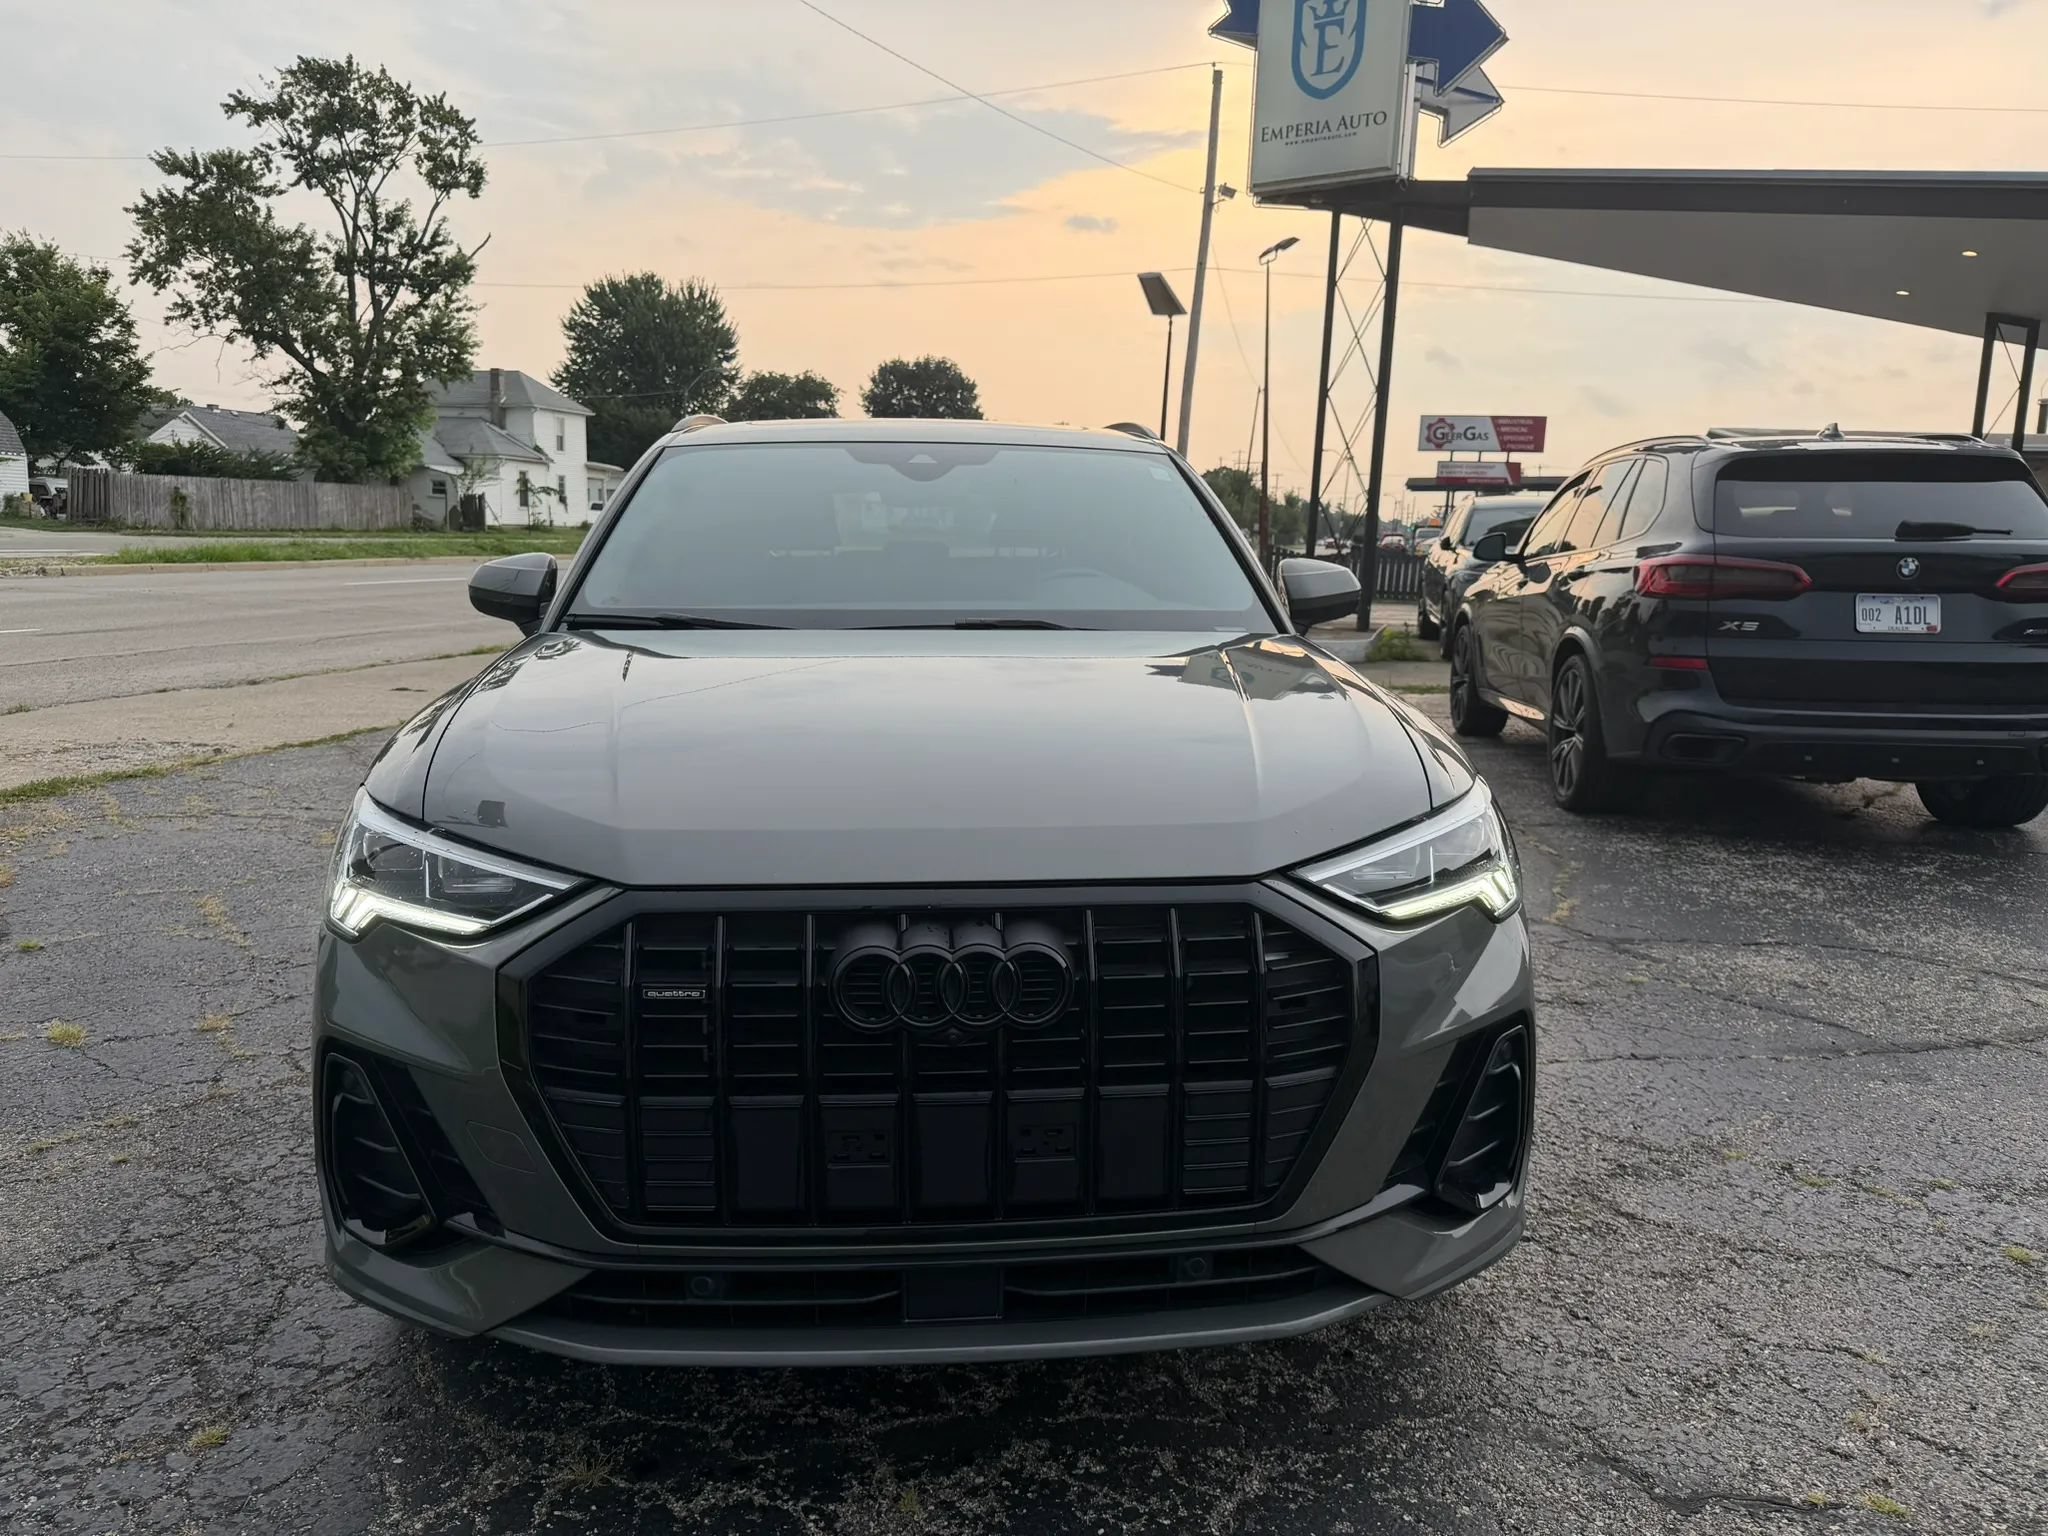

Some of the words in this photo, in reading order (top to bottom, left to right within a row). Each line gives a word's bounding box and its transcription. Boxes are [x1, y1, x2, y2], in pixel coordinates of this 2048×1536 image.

[1261, 119, 1332, 143] EMPERIA
[1336, 110, 1387, 132] AUTO
[1895, 605, 1931, 625] A1DL
[1718, 620, 1760, 631] X5
